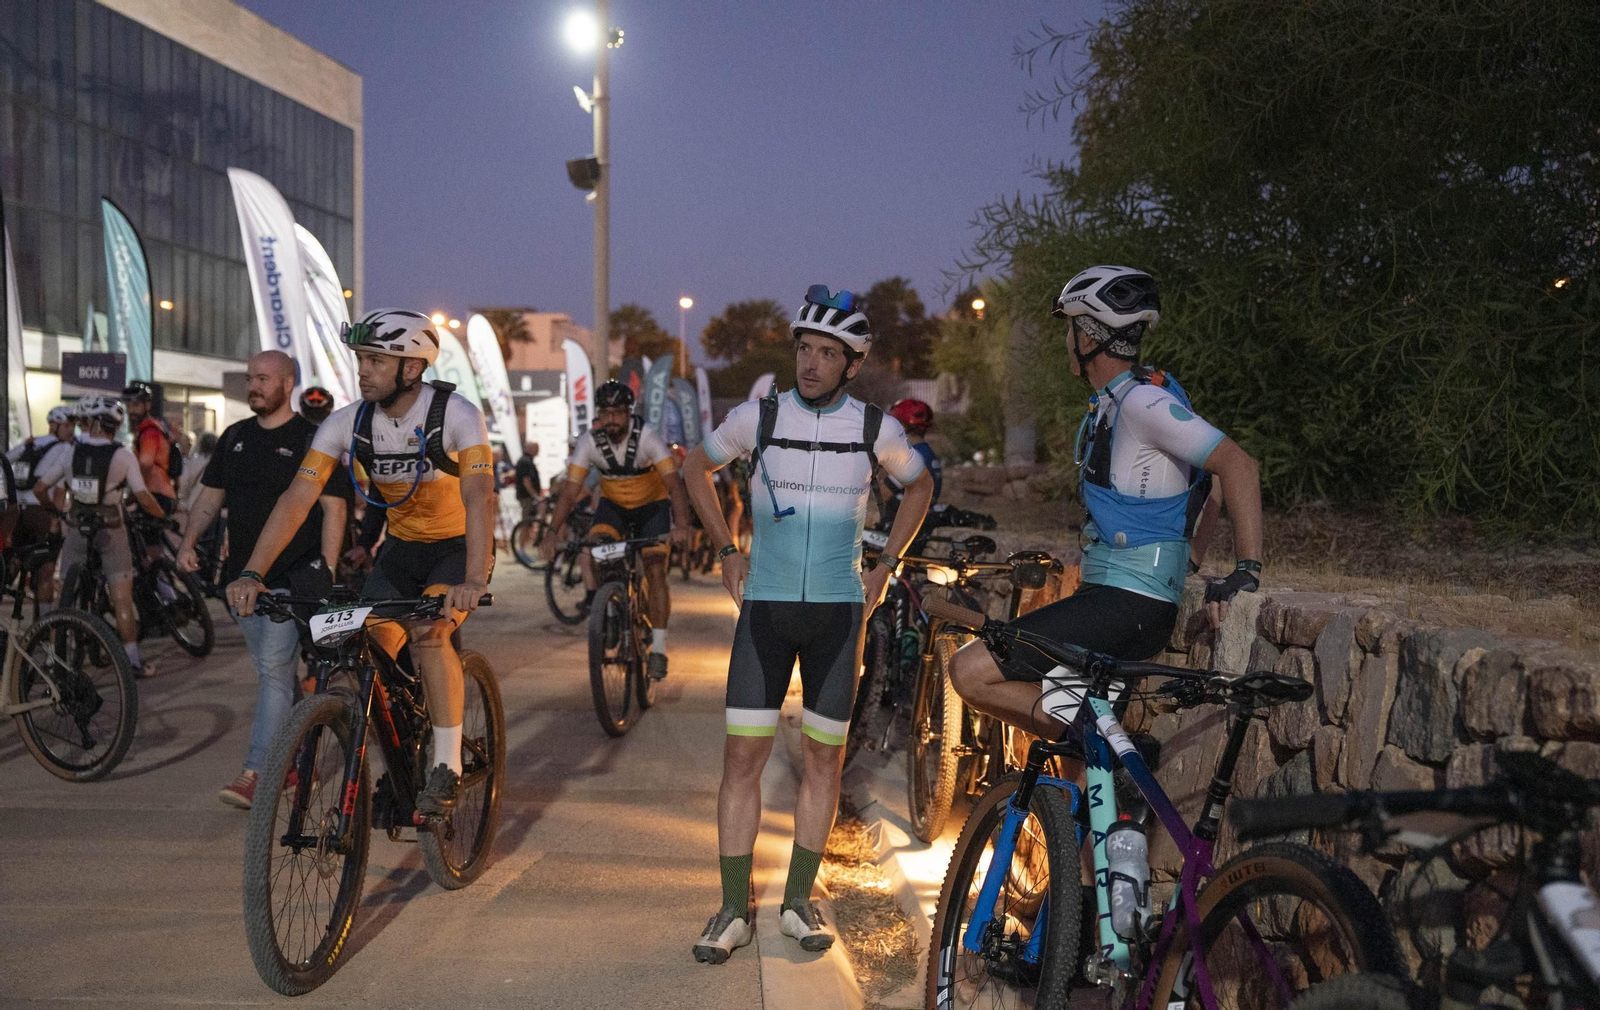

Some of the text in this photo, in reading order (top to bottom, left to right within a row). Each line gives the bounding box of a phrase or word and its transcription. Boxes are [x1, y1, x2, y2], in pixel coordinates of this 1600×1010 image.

[1064, 294, 1088, 304] SCOTT
[79, 366, 109, 380] BOX 3
[299, 467, 317, 477] PSOL
[372, 461, 430, 475] REPSO
[325, 610, 354, 624] 413
[328, 915, 353, 966] MAXXIS
